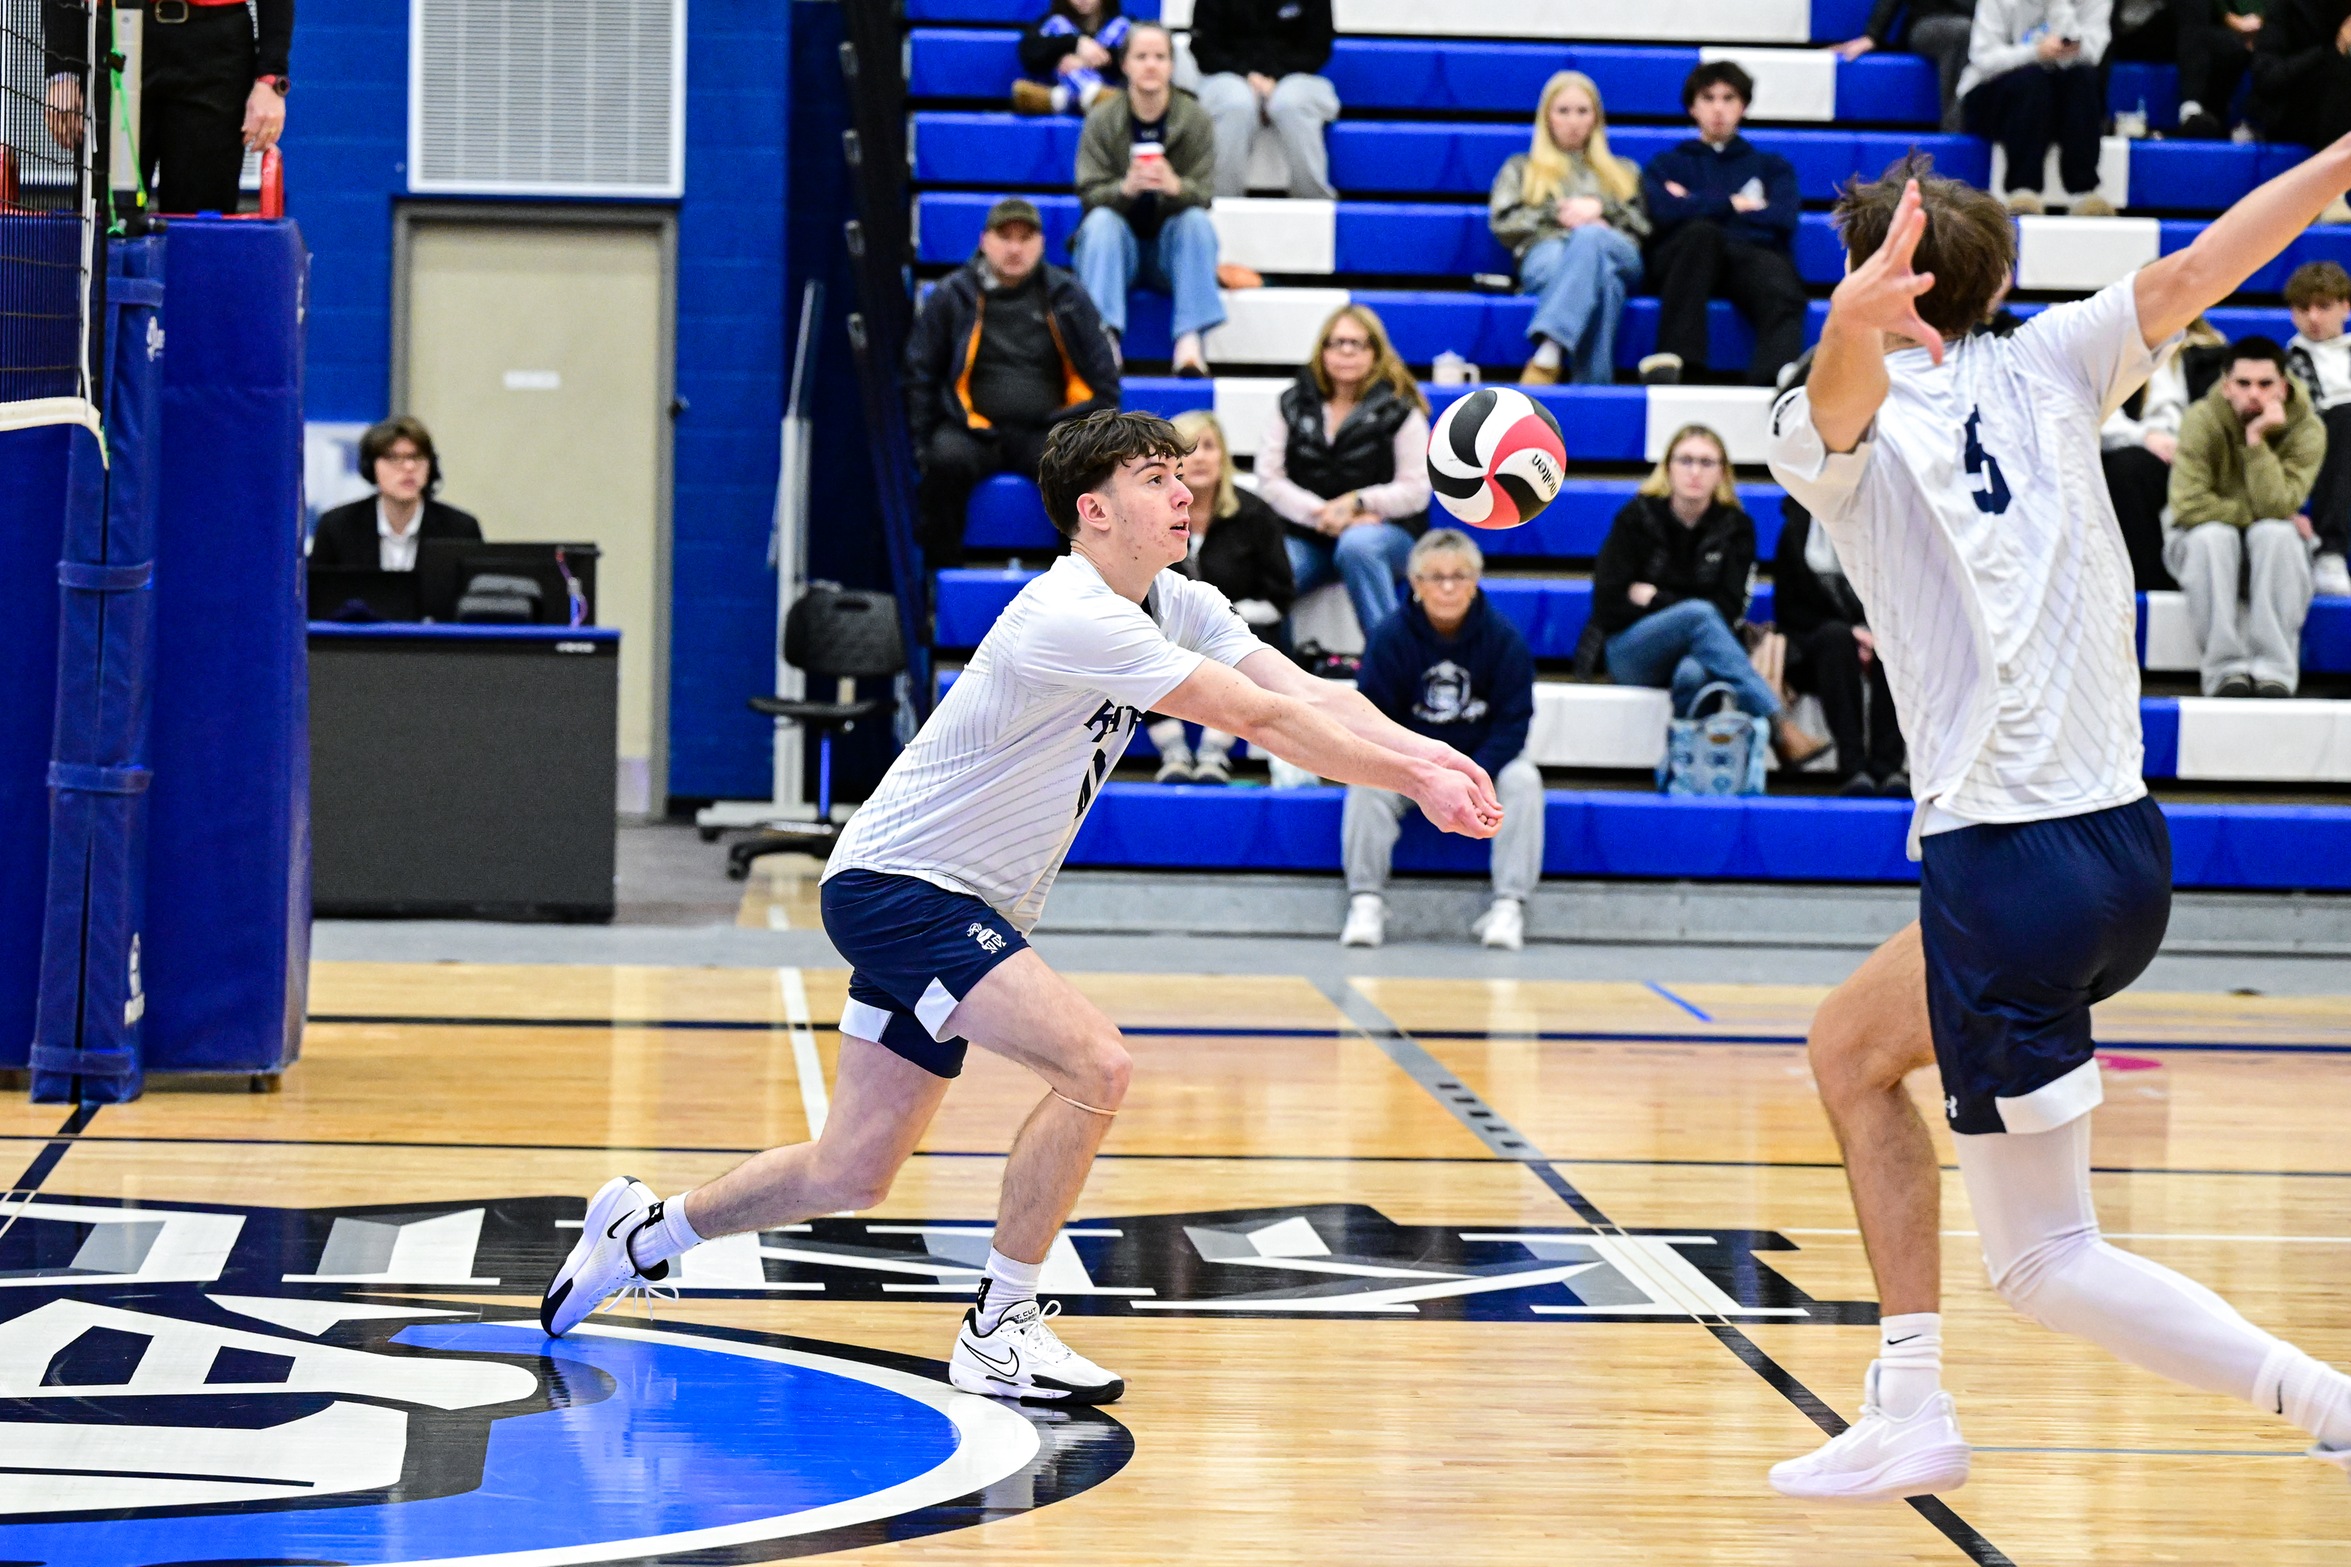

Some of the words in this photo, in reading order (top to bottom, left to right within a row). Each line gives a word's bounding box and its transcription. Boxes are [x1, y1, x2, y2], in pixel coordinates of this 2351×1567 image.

[1532, 454, 1557, 496] molten
[1964, 403, 2012, 515] 5
[1022, 1307, 1037, 1317] CUT
